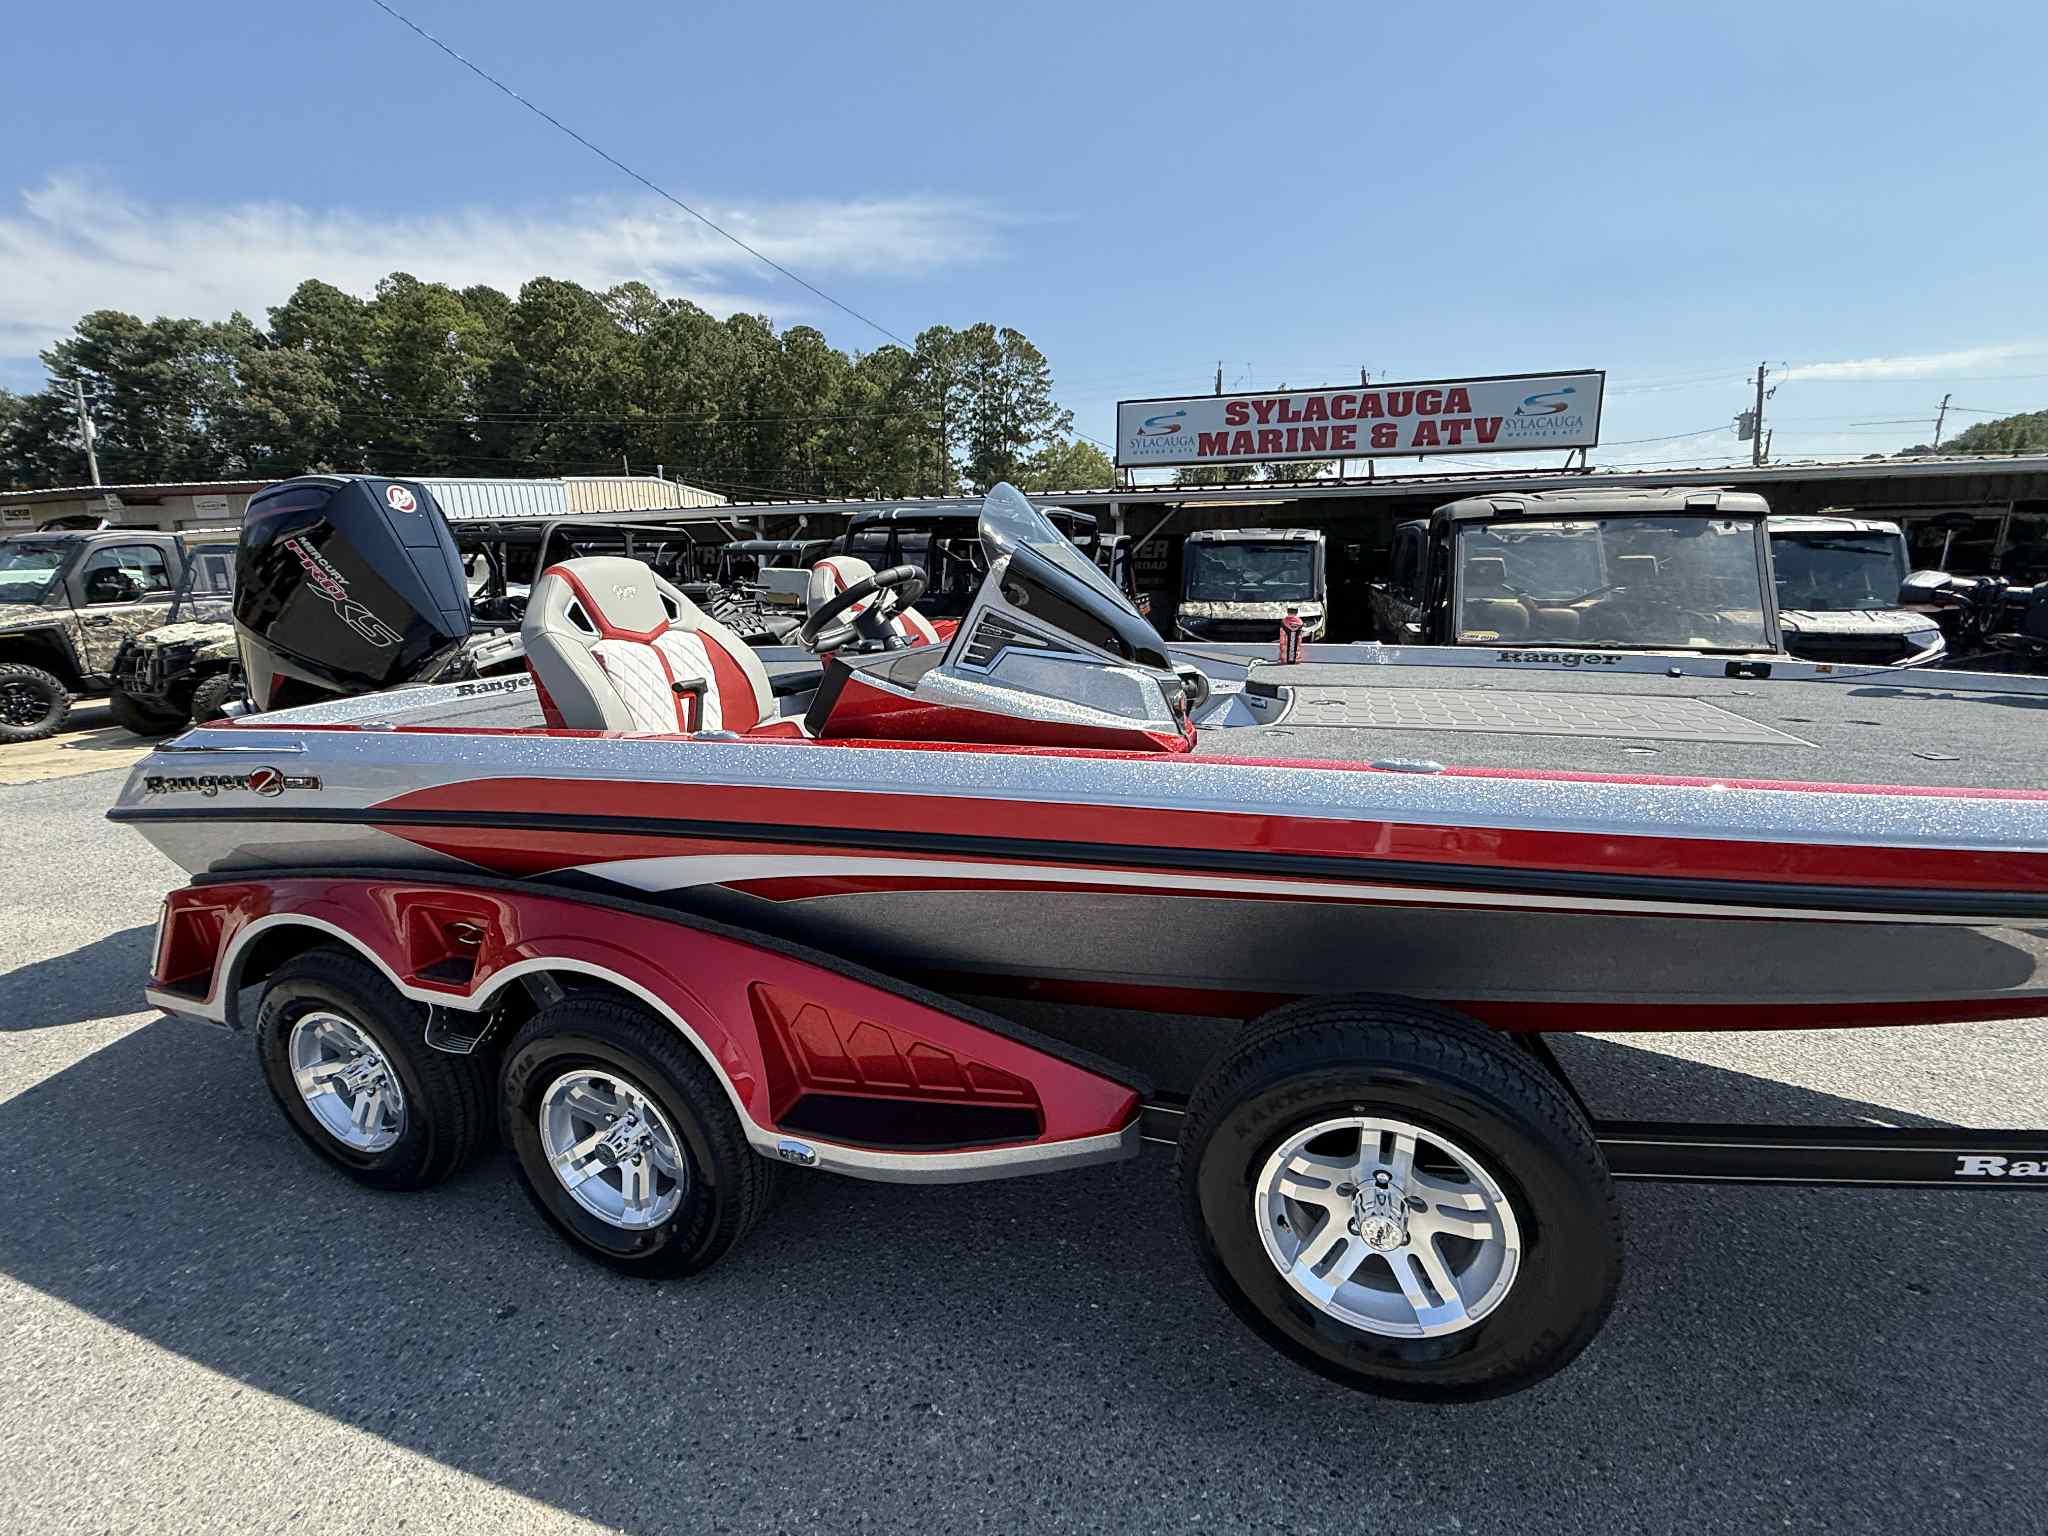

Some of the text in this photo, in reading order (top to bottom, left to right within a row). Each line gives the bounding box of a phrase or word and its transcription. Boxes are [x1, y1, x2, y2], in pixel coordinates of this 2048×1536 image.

[1225, 387, 1472, 426] SYLACAUGA
[1504, 416, 1584, 431] SYLACAUGA
[1128, 435, 1195, 449] SYLACAUGA
[1197, 416, 1504, 456] MARINE & ATV
[298, 536, 350, 585] MERCURY
[284, 539, 405, 648] PRO XS
[1495, 650, 1623, 668] Ranger
[143, 775, 250, 798] Ranger
[1954, 1154, 2048, 1177] Ra
